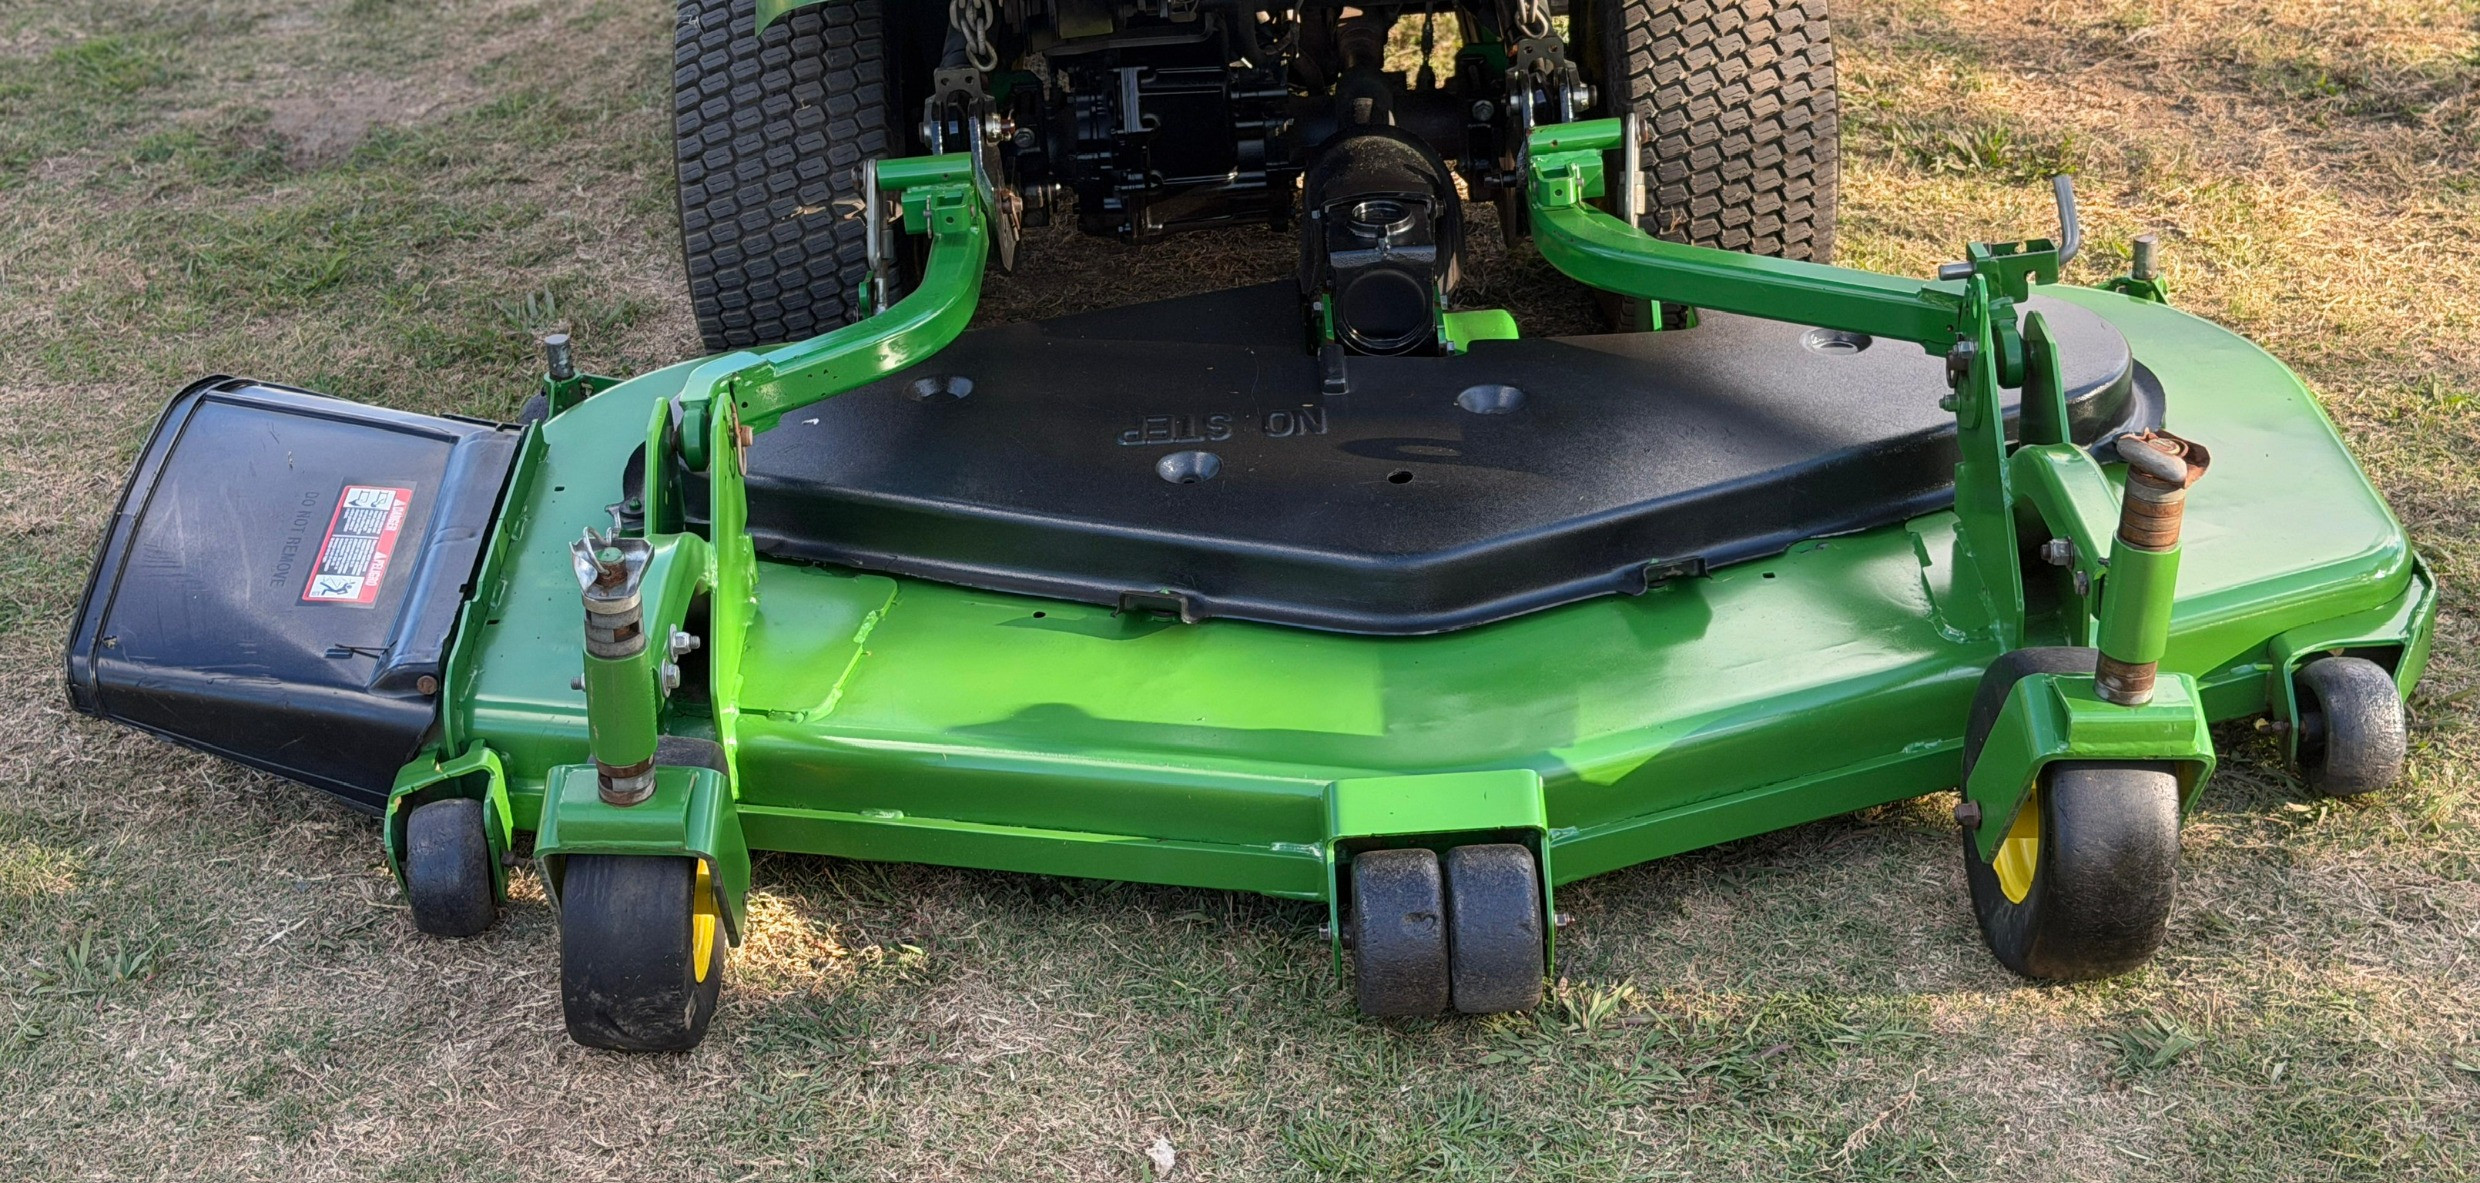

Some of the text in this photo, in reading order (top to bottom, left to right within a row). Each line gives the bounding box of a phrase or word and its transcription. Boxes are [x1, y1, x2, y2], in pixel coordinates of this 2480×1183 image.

[1116, 407, 1328, 446] NO STEP
[385, 506, 405, 531] DANGER
[270, 491, 319, 588] DO NOT REMOVE
[364, 559, 386, 586] PELIGRO
